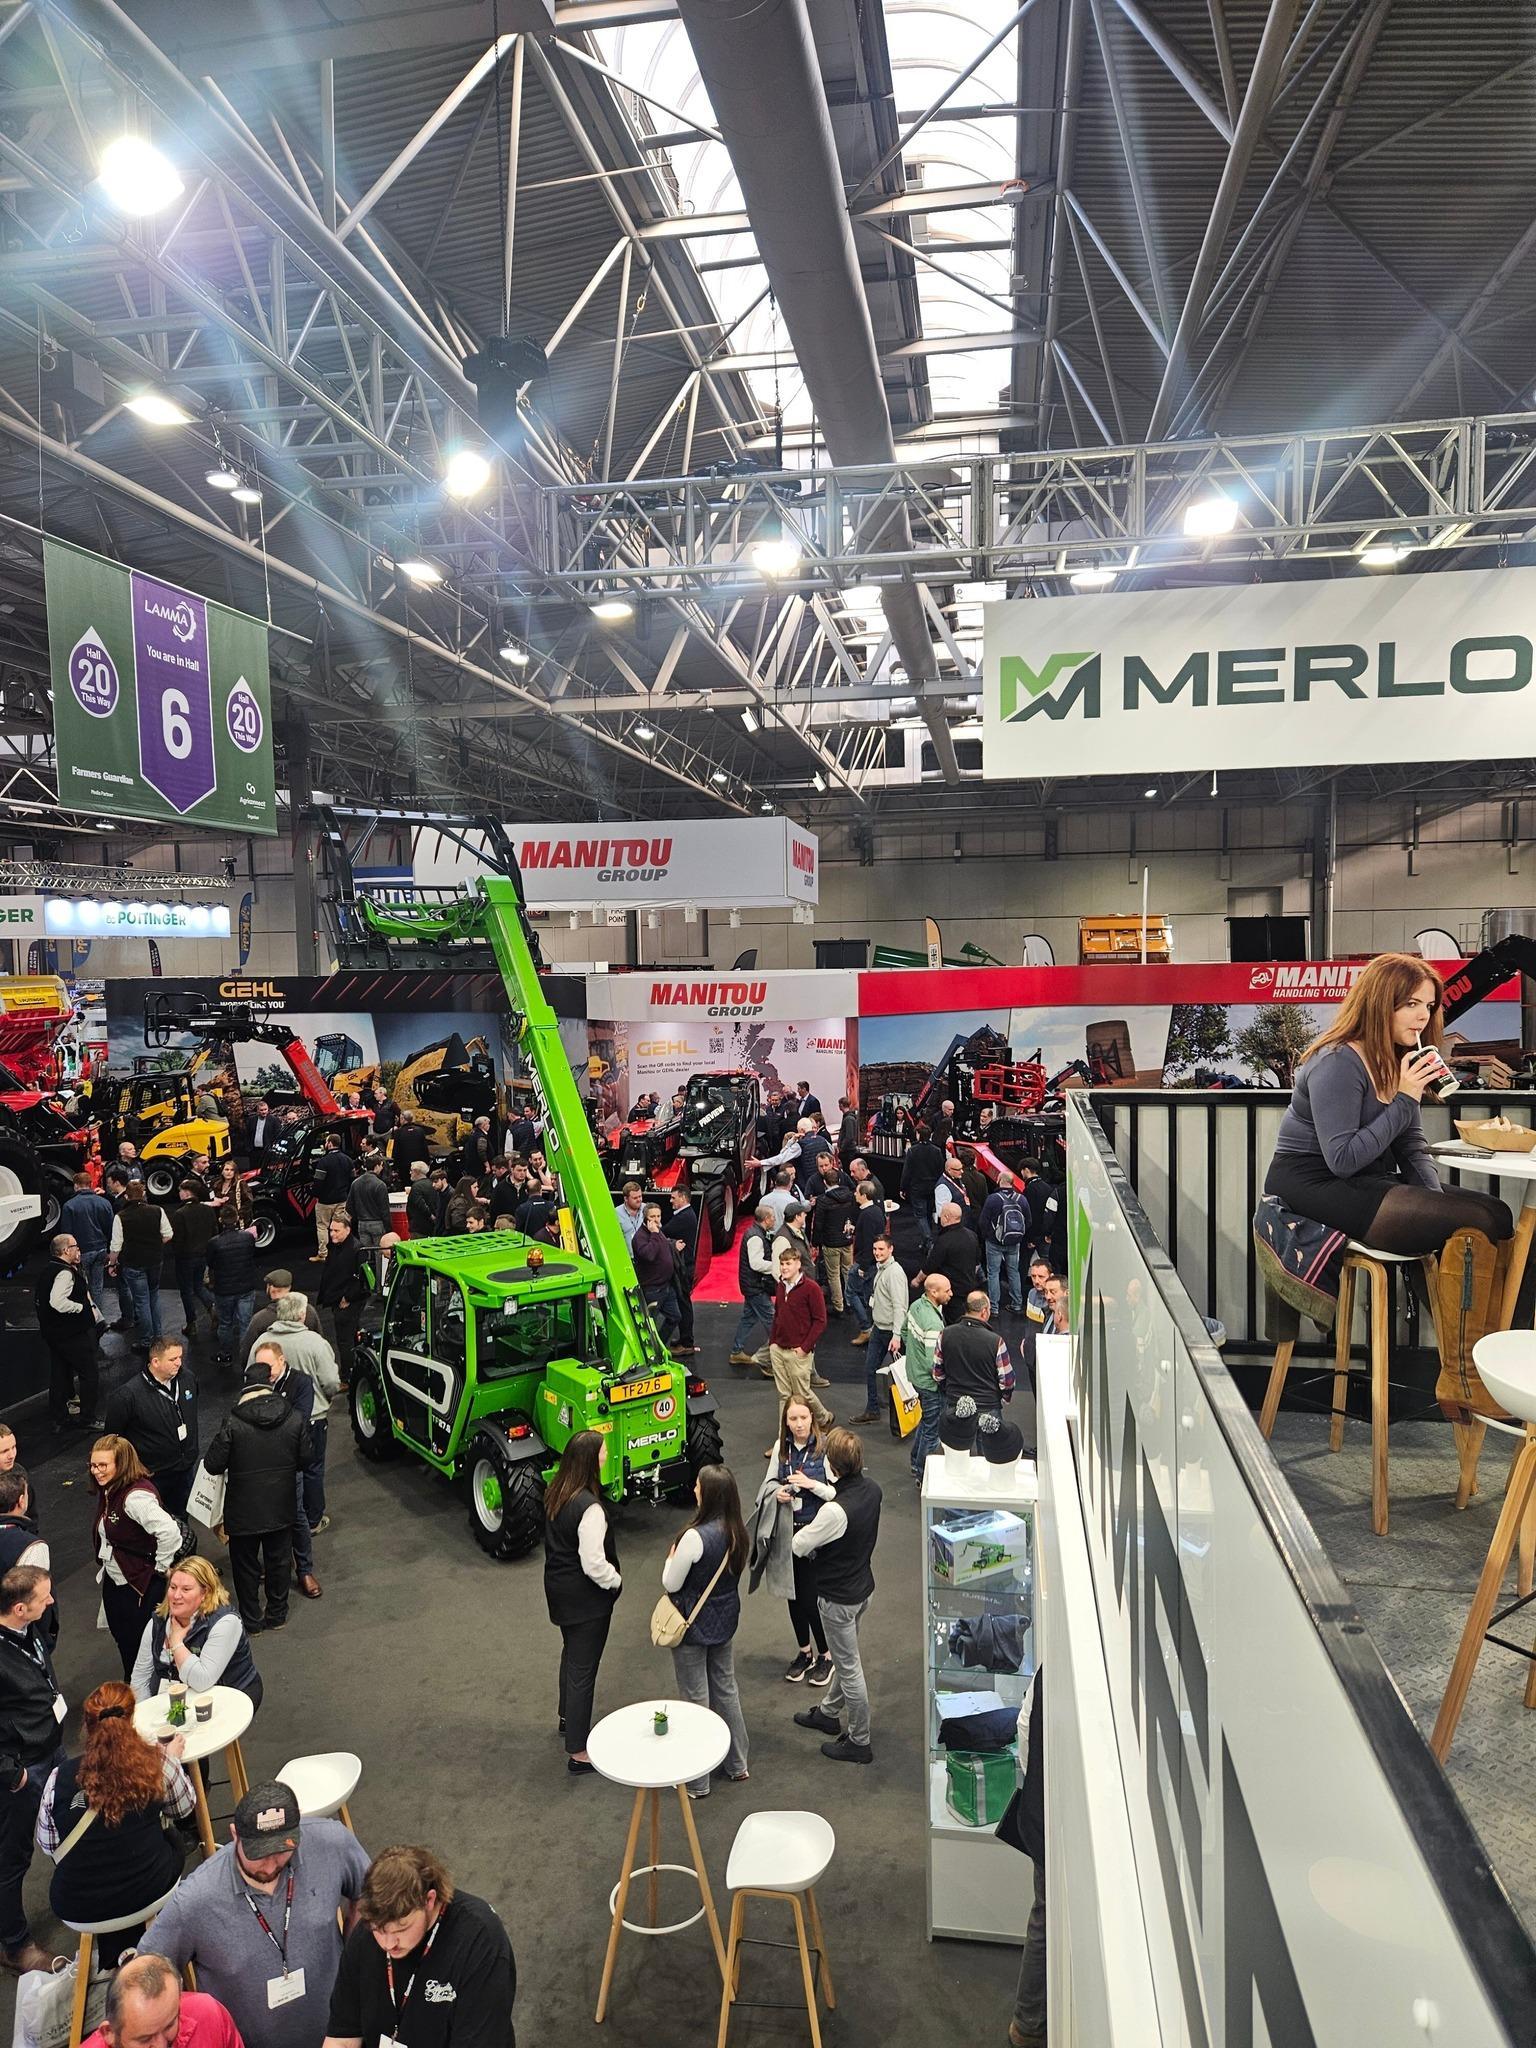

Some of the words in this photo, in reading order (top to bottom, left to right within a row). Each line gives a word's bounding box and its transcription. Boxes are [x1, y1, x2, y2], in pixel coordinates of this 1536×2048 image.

[145, 600, 188, 627] LAMMA
[86, 647, 101, 661] Hall
[147, 645, 161, 660] You
[163, 653, 176, 665] are
[177, 655, 184, 667] in
[185, 657, 199, 672] Hall
[78, 658, 110, 696] 20
[1123, 635, 1533, 711] MERLO
[81, 691, 96, 704] This
[97, 695, 111, 709] Way
[238, 693, 249, 705] Hall
[162, 688, 192, 760] 6
[232, 703, 256, 734] 20
[234, 731, 245, 742] This
[246, 734, 256, 745] Way
[72, 766, 101, 780] Farmers
[103, 771, 133, 785] Guardian
[519, 838, 673, 869] MANITOU
[792, 839, 814, 874] MANITOU
[596, 868, 668, 882] GROUP
[219, 981, 284, 998] GEHL
[650, 982, 767, 1005] MANITOU
[1273, 988, 1319, 997] HANDLING
[1323, 988, 1348, 997] YOUR
[268, 1001, 285, 1009] YOU
[707, 1006, 763, 1017] GROUP
[637, 1040, 698, 1057] GEHL
[525, 1052, 560, 1152] MERLO
[698, 1104, 725, 1128] PREVIEW
[622, 1378, 661, 1398] TF27.6
[659, 1401, 670, 1412] 40
[628, 1429, 677, 1450] MERLO
